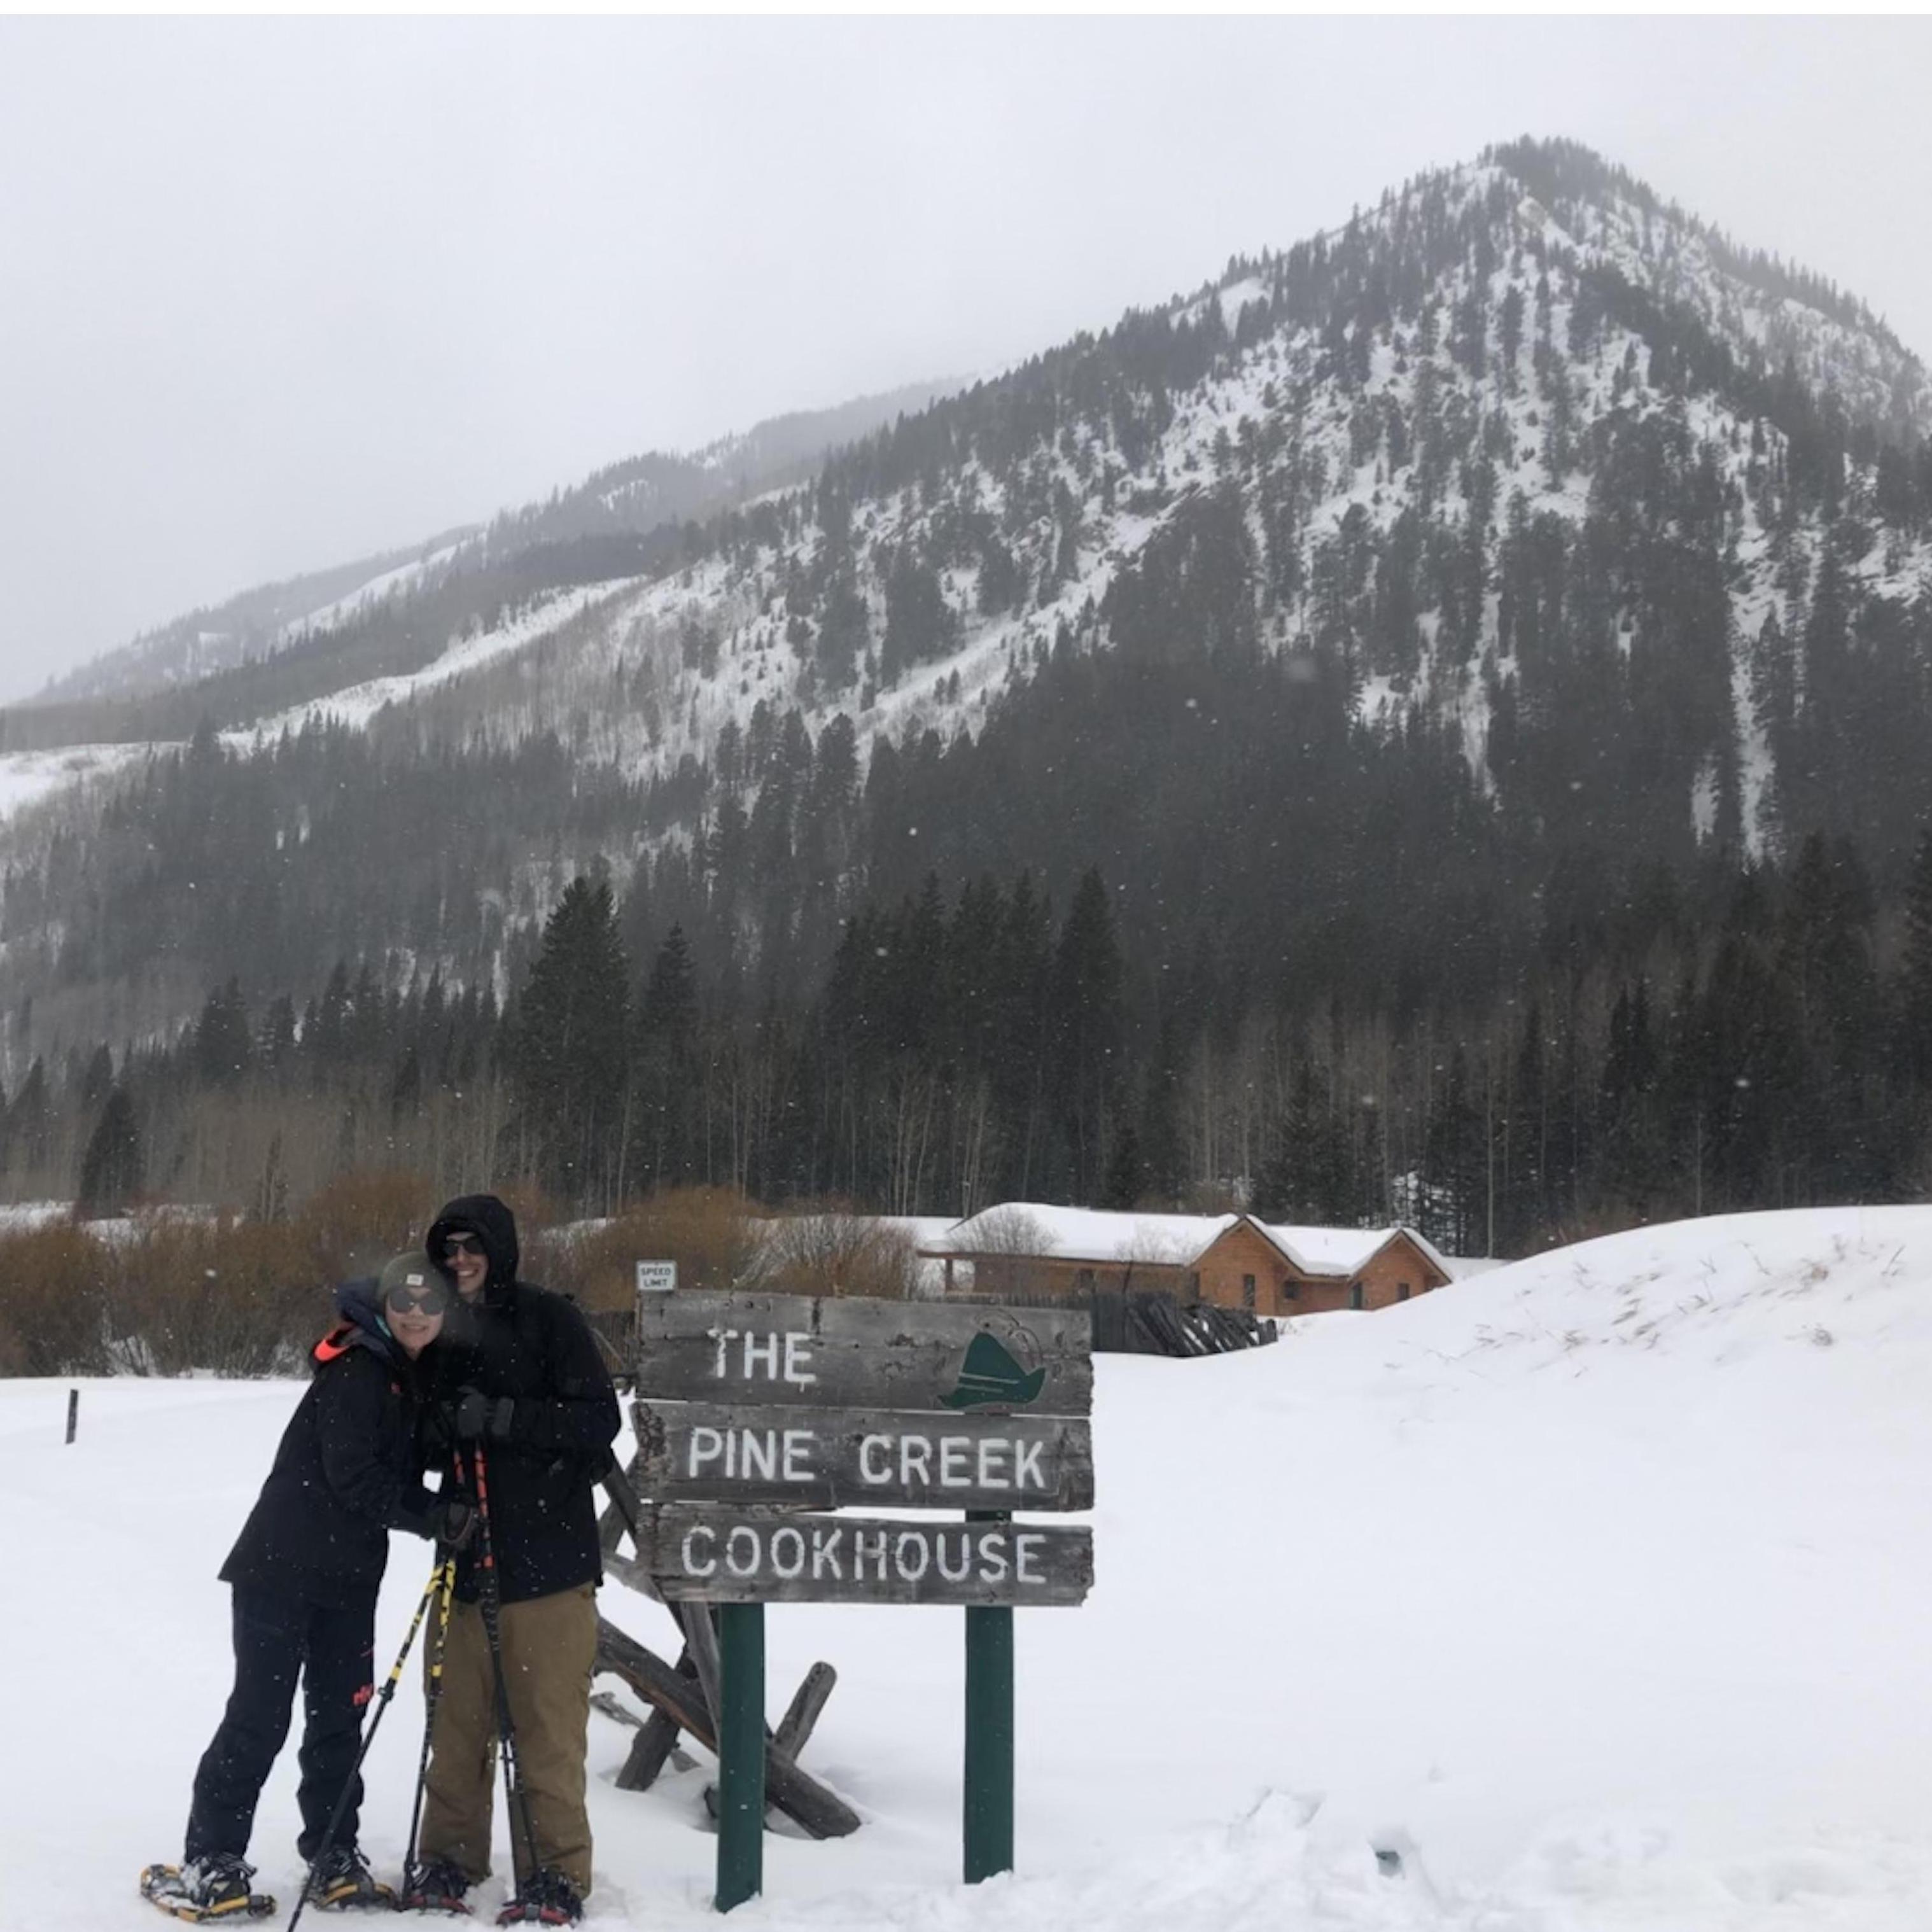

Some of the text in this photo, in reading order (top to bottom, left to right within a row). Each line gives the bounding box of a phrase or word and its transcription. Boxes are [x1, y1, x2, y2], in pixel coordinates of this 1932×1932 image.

[641, 1267, 671, 1276] SPEED
[708, 1329, 817, 1383] THE
[689, 1427, 1045, 1488] PINE CREEK
[681, 1526, 1047, 1584] COOKHOUSE
